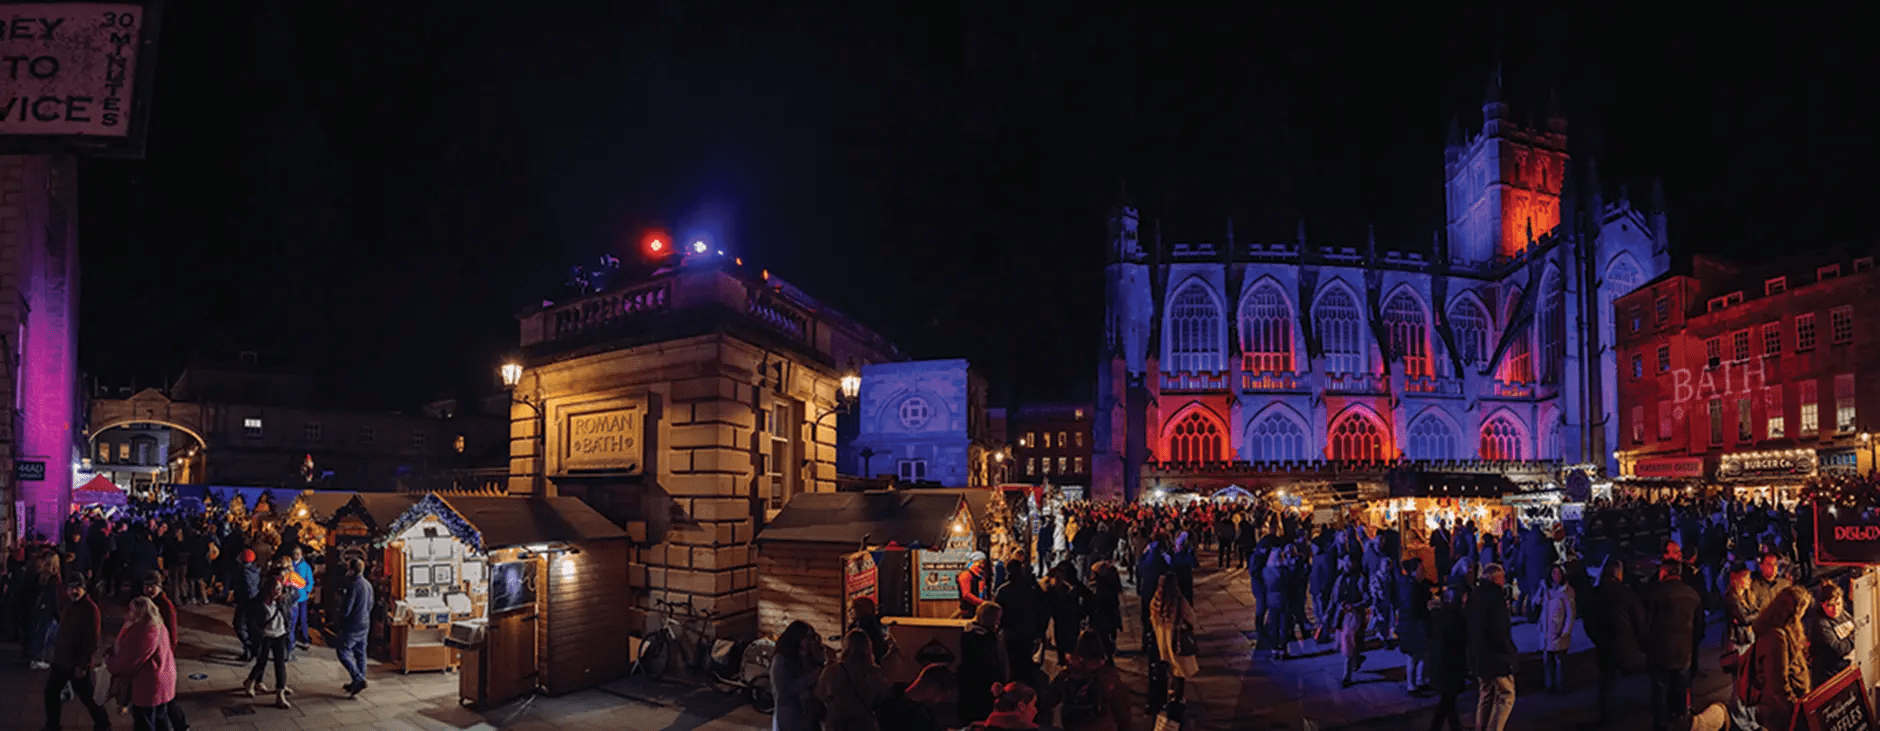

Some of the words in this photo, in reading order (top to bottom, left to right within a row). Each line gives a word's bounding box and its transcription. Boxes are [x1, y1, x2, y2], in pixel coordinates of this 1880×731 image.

[0, 18, 65, 41] EY
[101, 12, 134, 27] 30
[3, 56, 59, 79] TO
[101, 32, 130, 126] MINUTES
[1672, 354, 1771, 404] BATH
[575, 413, 633, 436] ROMAN
[583, 434, 624, 454] BATH
[1744, 459, 1778, 470] BURGER
